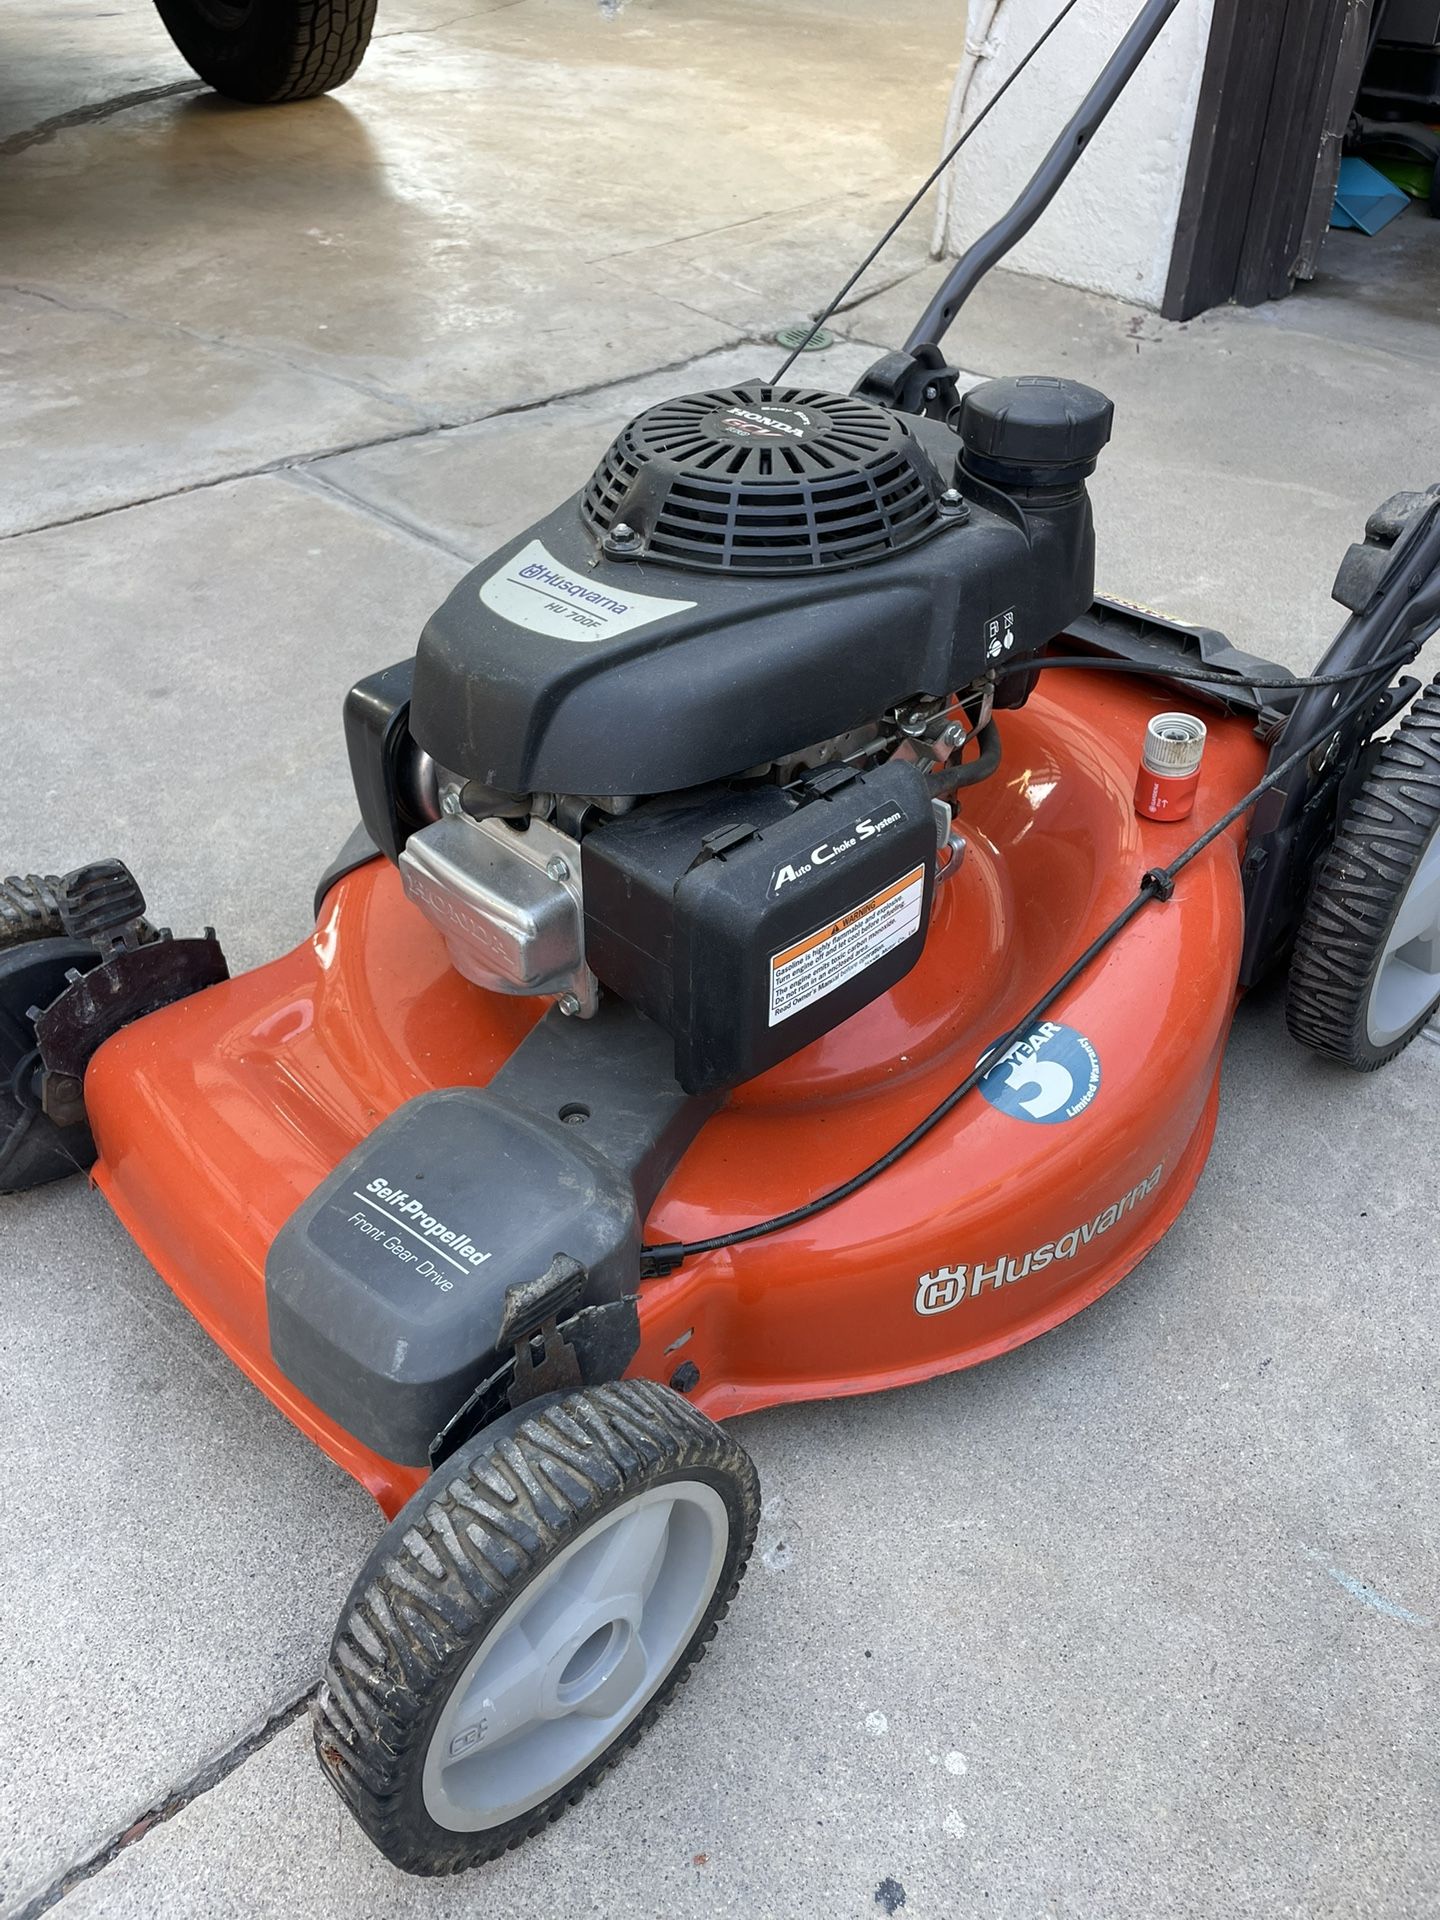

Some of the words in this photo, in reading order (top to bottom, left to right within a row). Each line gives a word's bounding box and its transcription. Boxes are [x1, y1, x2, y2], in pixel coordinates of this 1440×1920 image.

[722, 418, 784, 438] GCV
[726, 407, 804, 438] HONDA
[535, 570, 628, 615] Husqvarna
[544, 602, 567, 614] HU
[565, 611, 602, 628] 700F
[774, 864, 812, 891] Auto
[811, 837, 857, 865] Choke
[855, 812, 901, 841] System
[407, 873, 515, 966] HONDA
[841, 901, 876, 927] WARNING
[775, 957, 803, 977] Gasoline
[805, 953, 811, 962] is
[812, 942, 831, 958] highly
[832, 921, 863, 944] flammable
[865, 912, 876, 922] and
[775, 973, 791, 985] Turn
[792, 961, 814, 977] engine
[815, 953, 824, 963] off
[825, 946, 838, 957] and
[839, 940, 847, 950] let
[847, 930, 861, 946] cool
[861, 918, 879, 934] before
[775, 985, 788, 997] The
[790, 972, 811, 988] engine
[812, 962, 830, 973] emits
[831, 952, 846, 964] toxic
[847, 937, 868, 955] carbon
[774, 1003, 791, 1016] Read
[792, 988, 817, 1006] Owner's
[818, 975, 840, 990] Manual
[840, 962, 858, 977] before
[775, 995, 784, 1005] Do
[786, 989, 797, 999] not
[798, 983, 810, 994] run
[810, 978, 817, 987] in
[818, 973, 826, 981] an
[828, 955, 854, 976] enclosed
[1006, 1022, 1062, 1066] YEAR
[1077, 1037, 1100, 1082] Warranty
[1066, 1084, 1097, 1118] Limited
[366, 1178, 492, 1266] Self-Propelled
[970, 1163, 1163, 1297] Husqvarna
[348, 1212, 386, 1241] Front
[383, 1236, 418, 1264] Gear
[415, 1260, 454, 1292] Drive
